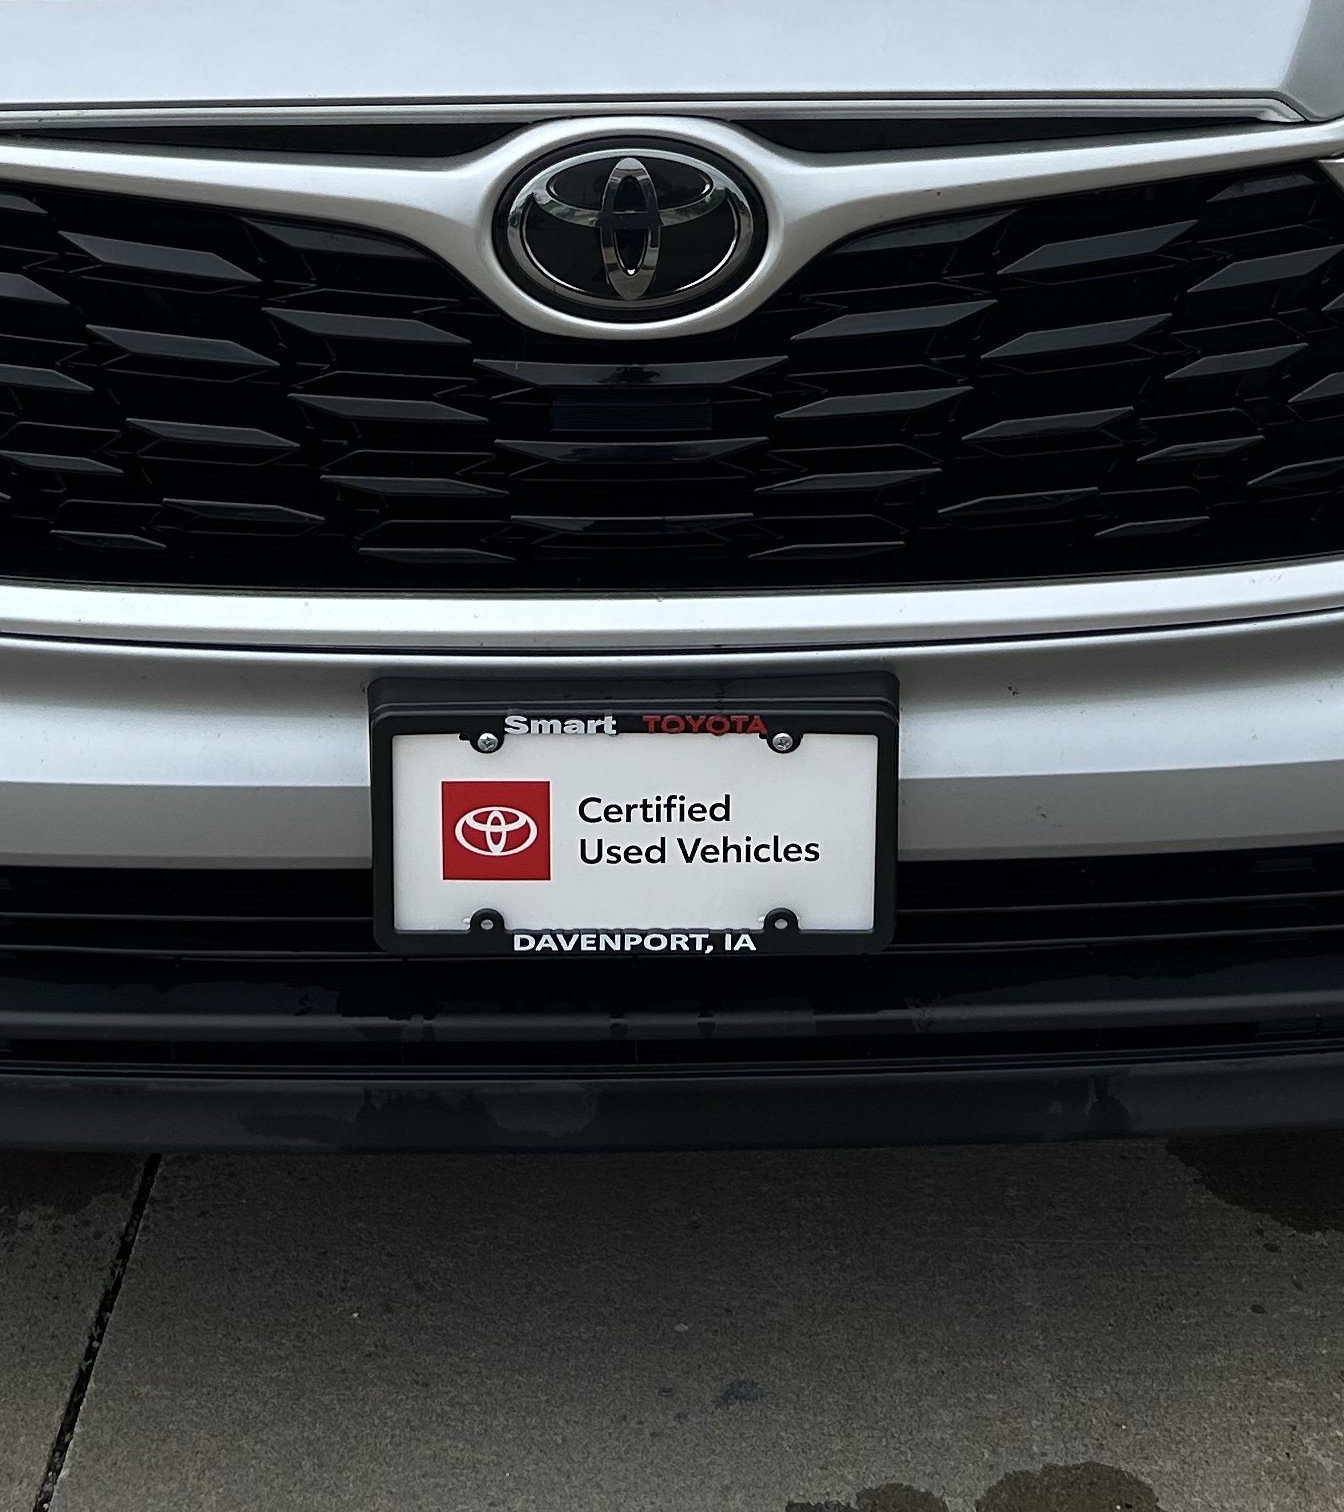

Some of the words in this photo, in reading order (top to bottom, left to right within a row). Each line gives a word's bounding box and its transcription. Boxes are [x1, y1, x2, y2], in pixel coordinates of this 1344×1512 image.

[503, 715, 617, 735] Smart
[642, 714, 768, 736] TOYOTA
[577, 793, 732, 824] Certified
[578, 836, 668, 865] Used
[676, 835, 821, 865] Vehicles
[513, 933, 714, 954] DAVENPORT,
[723, 933, 757, 951] IA
